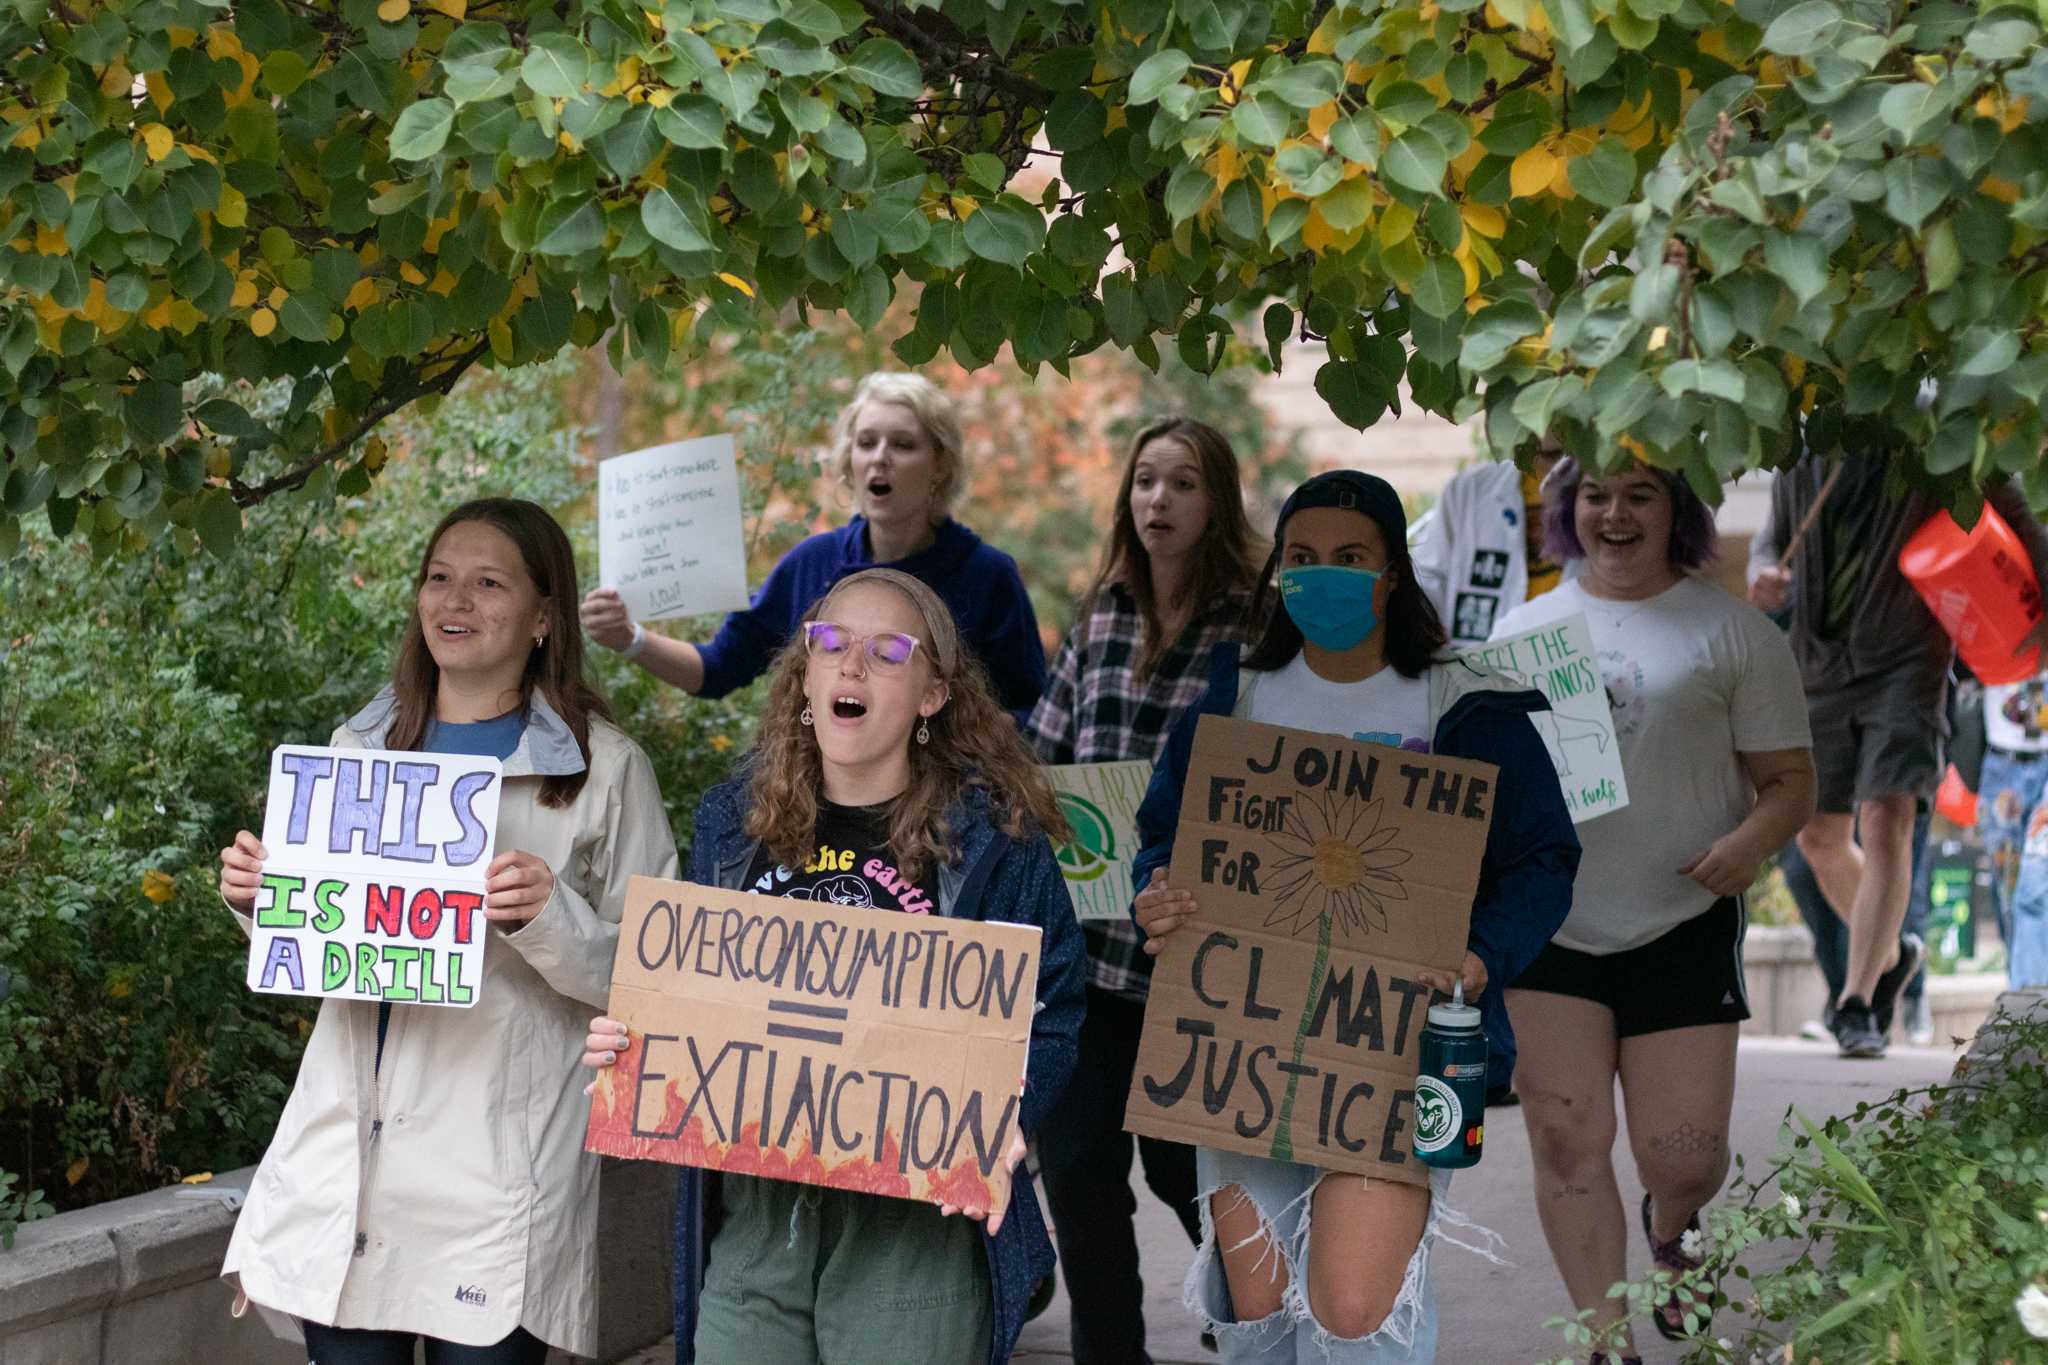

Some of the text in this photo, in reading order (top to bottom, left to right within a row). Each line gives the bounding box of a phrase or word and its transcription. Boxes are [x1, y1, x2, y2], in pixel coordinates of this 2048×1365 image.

[1524, 625, 1578, 667] THE
[282, 753, 496, 866] THIS
[1246, 735, 1489, 824] JOIN THE
[257, 873, 485, 944] IS NOT
[863, 858, 934, 916] earth
[259, 936, 473, 1004] A DRILL
[636, 899, 1029, 1020] OVERCONSUMPTION
[1191, 930, 1438, 1057] CLIMAT
[631, 1033, 1018, 1178] EXTINCTION
[1142, 1016, 1416, 1164] JUSTICE
[465, 1291, 486, 1303] REI
